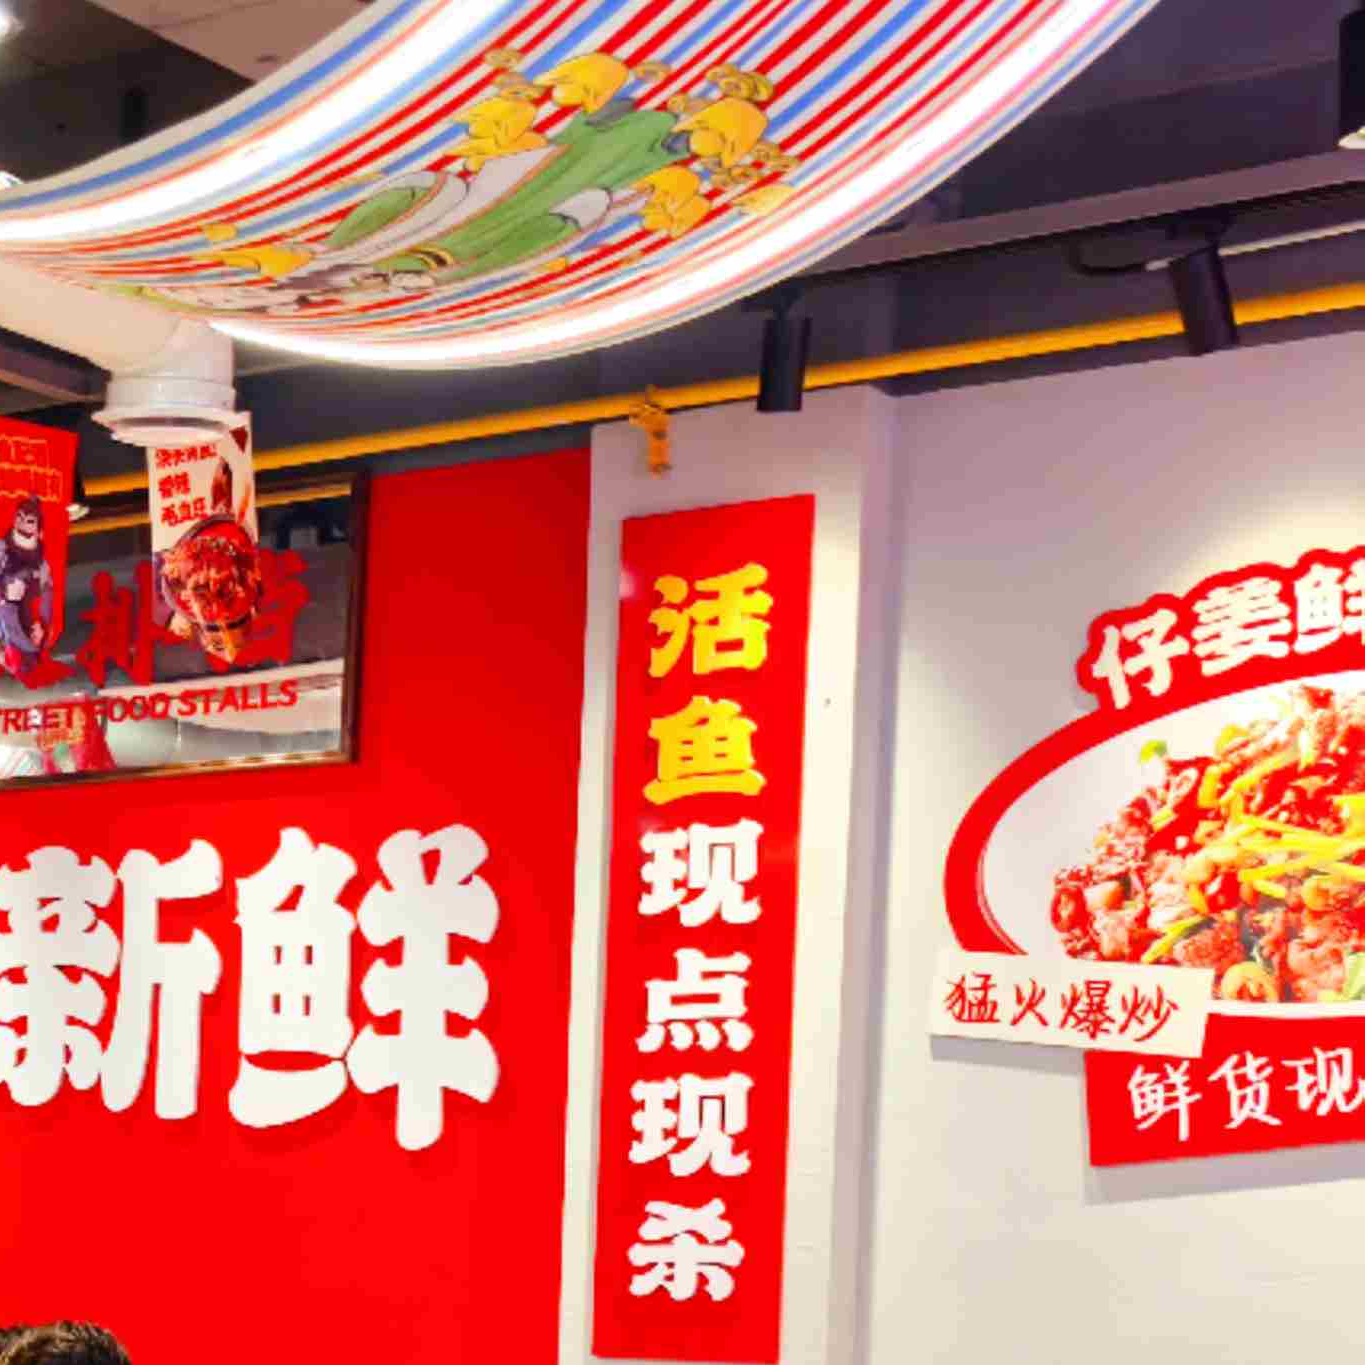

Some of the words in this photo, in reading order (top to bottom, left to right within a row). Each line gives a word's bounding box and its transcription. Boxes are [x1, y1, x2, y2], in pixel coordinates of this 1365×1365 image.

[177, 679, 300, 718] STALLS
[628, 560, 774, 1302] 活鱼现点现杀
[943, 971, 1180, 1043] 猛火爆炒
